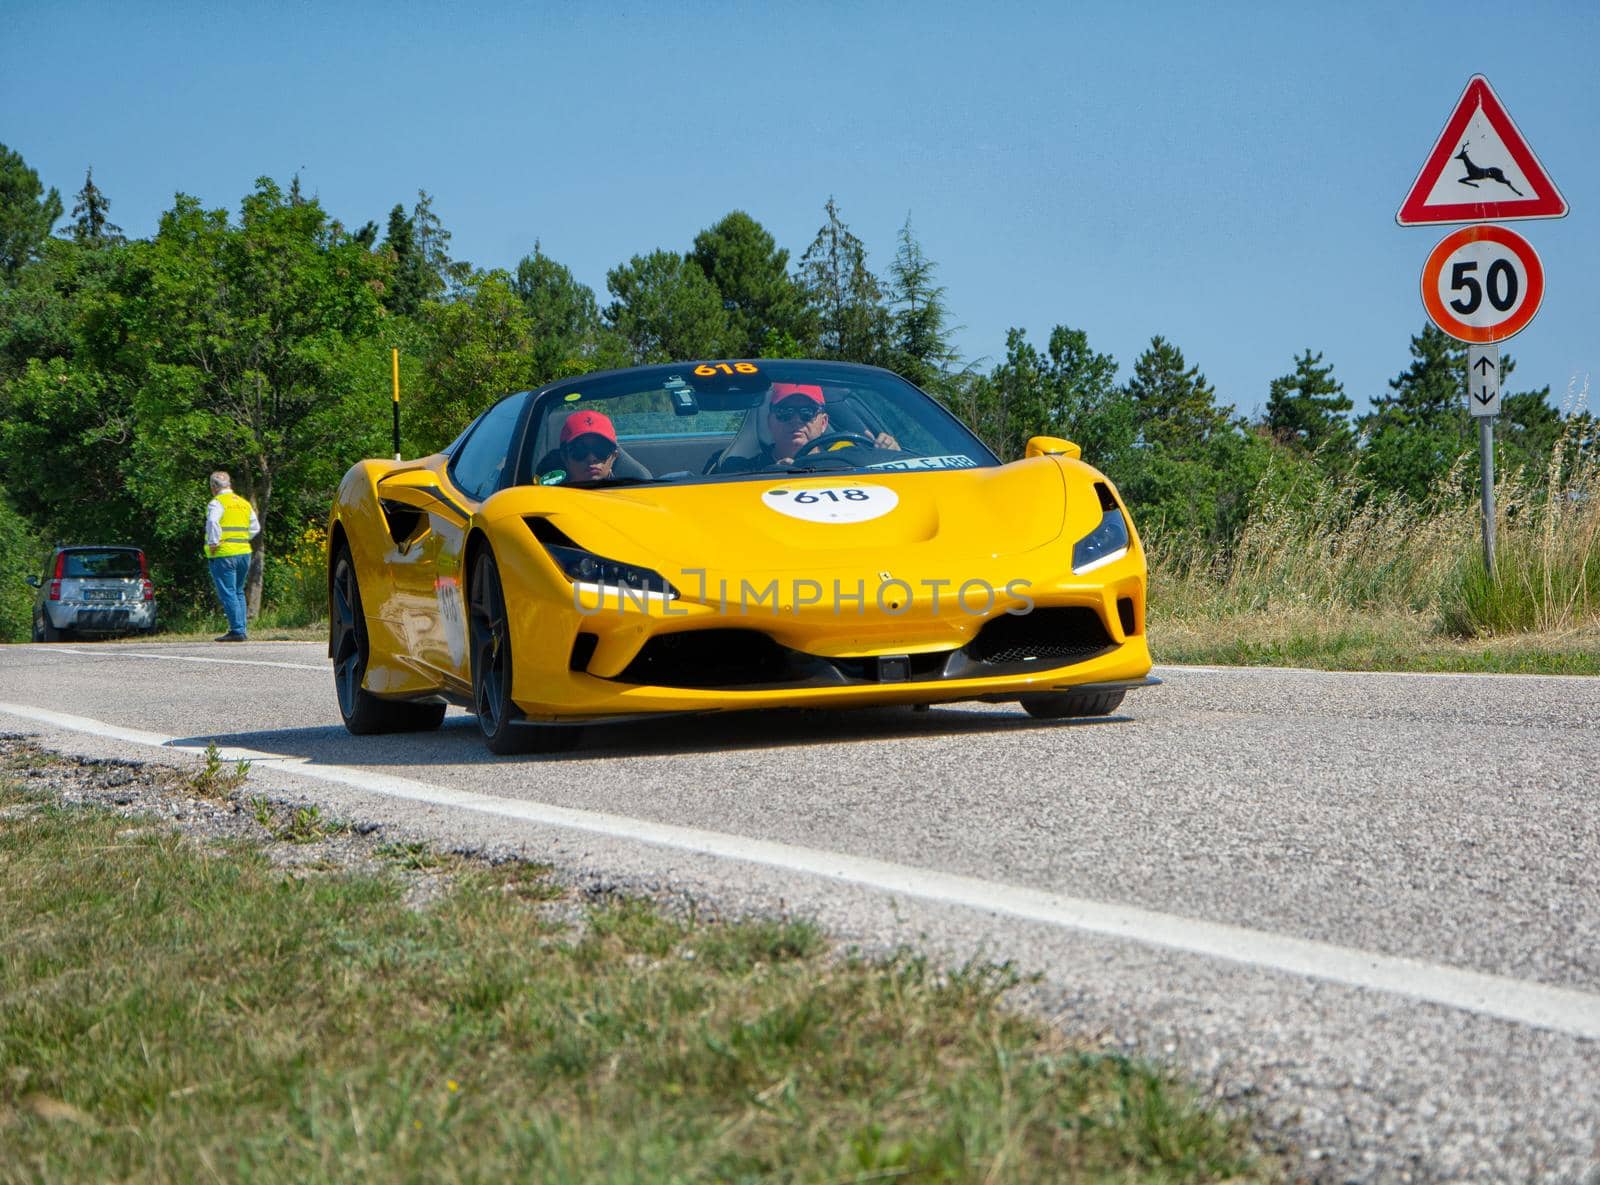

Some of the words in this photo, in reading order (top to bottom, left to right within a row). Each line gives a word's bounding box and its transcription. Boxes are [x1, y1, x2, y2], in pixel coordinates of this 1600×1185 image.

[1450, 258, 1518, 315] 50
[694, 362, 758, 376] 618
[794, 488, 870, 504] 618
